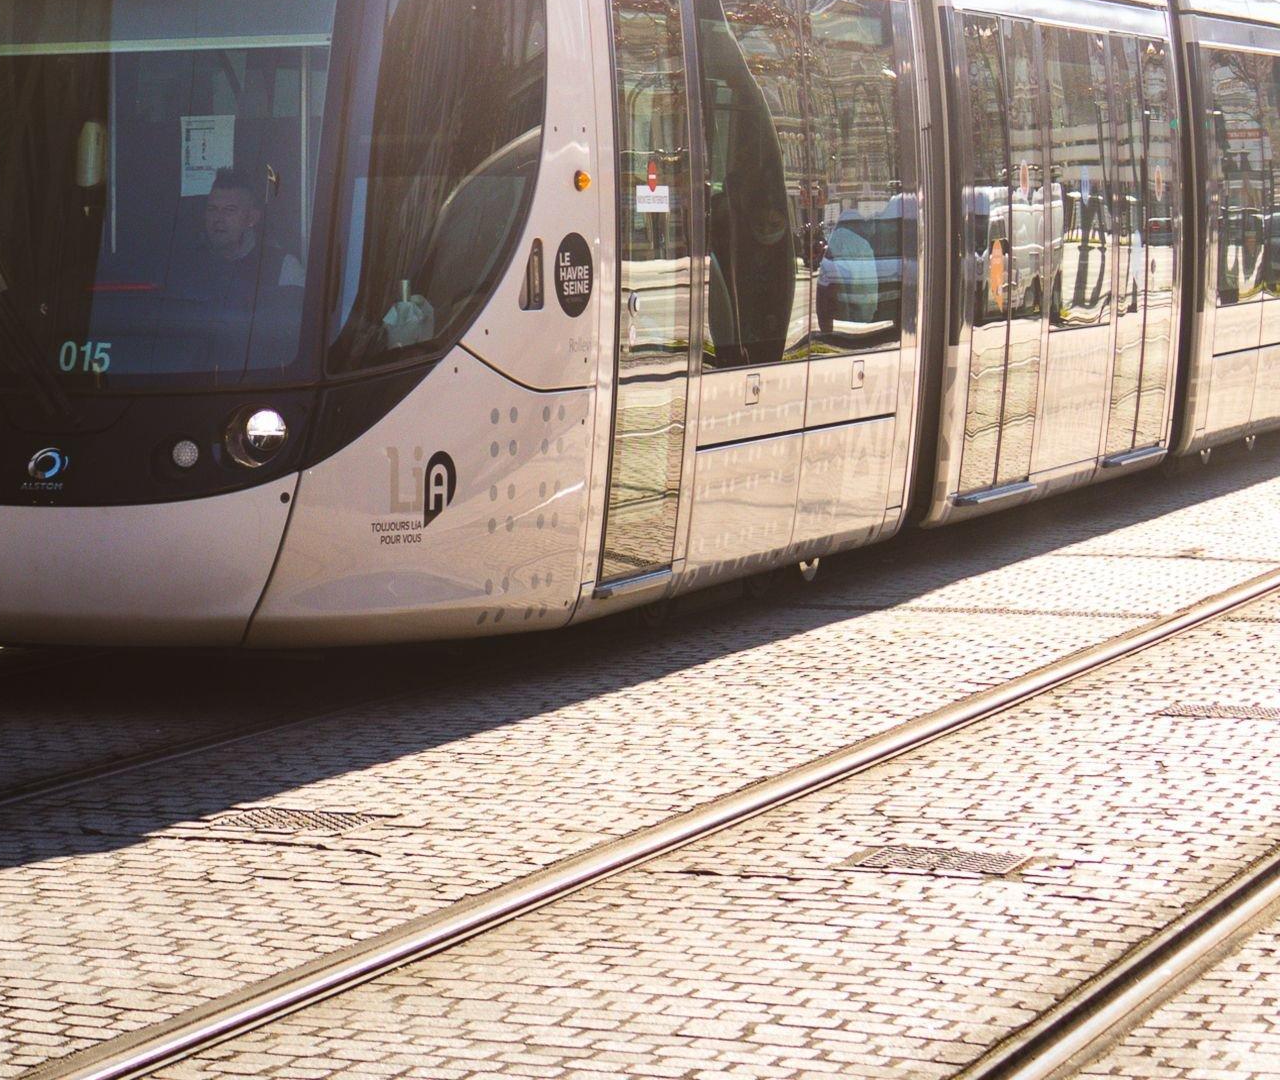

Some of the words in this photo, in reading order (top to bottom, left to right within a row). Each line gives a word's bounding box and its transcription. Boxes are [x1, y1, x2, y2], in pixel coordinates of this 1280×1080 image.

[559, 252, 571, 266] LE
[559, 265, 589, 281] HAVRE
[563, 280, 589, 296] SEINE
[59, 340, 112, 374] 015
[20, 481, 64, 491] ALSTOM
[371, 521, 410, 533] TOUJOURS
[380, 534, 401, 545] POUR
[402, 533, 422, 544] VOUS
